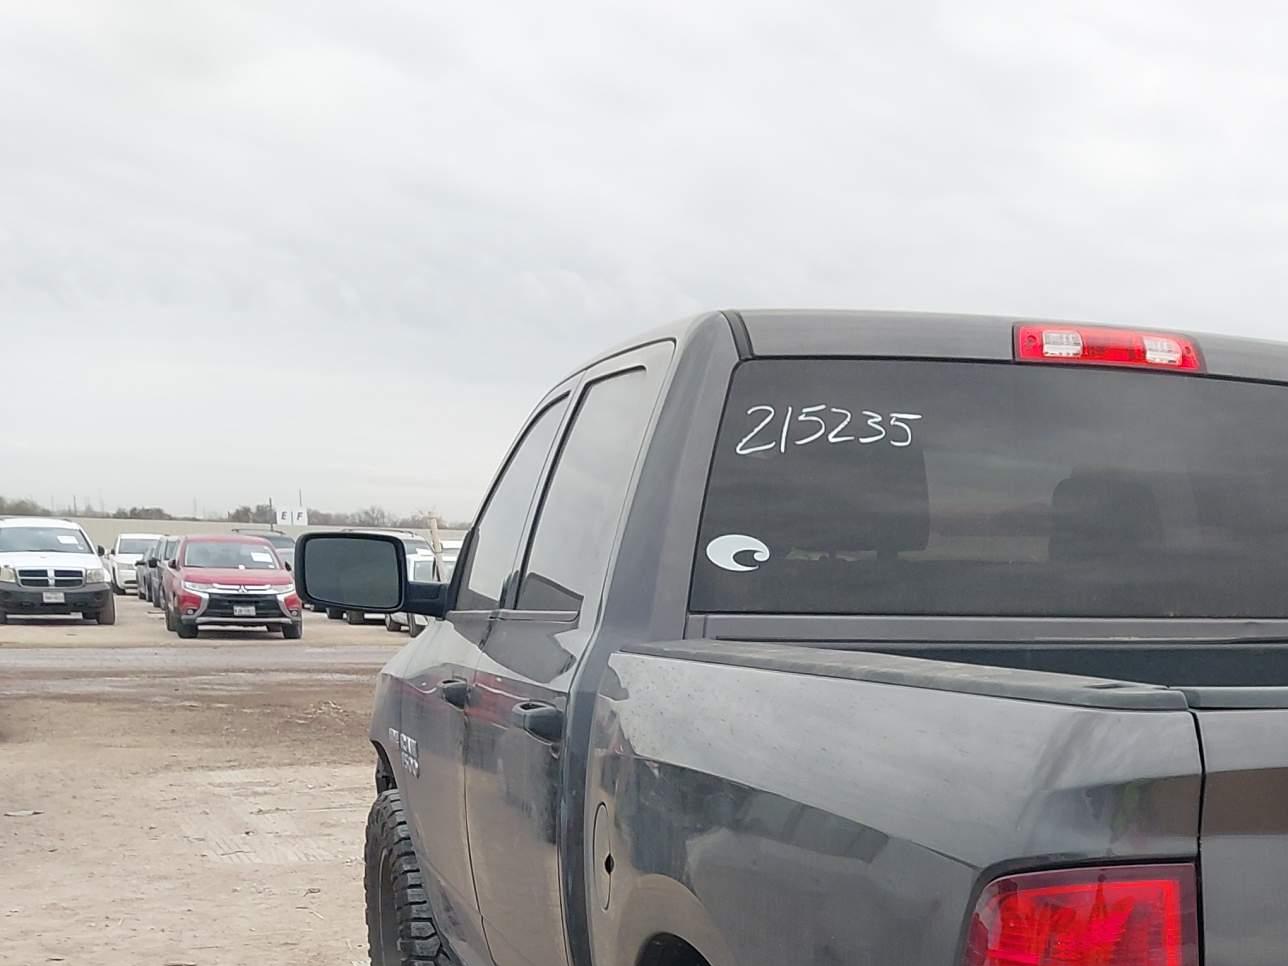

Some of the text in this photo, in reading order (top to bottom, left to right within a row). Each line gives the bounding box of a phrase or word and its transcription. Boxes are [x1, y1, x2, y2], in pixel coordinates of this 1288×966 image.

[735, 404, 922, 455] 215235
[281, 511, 288, 520] E
[296, 511, 304, 521] F
